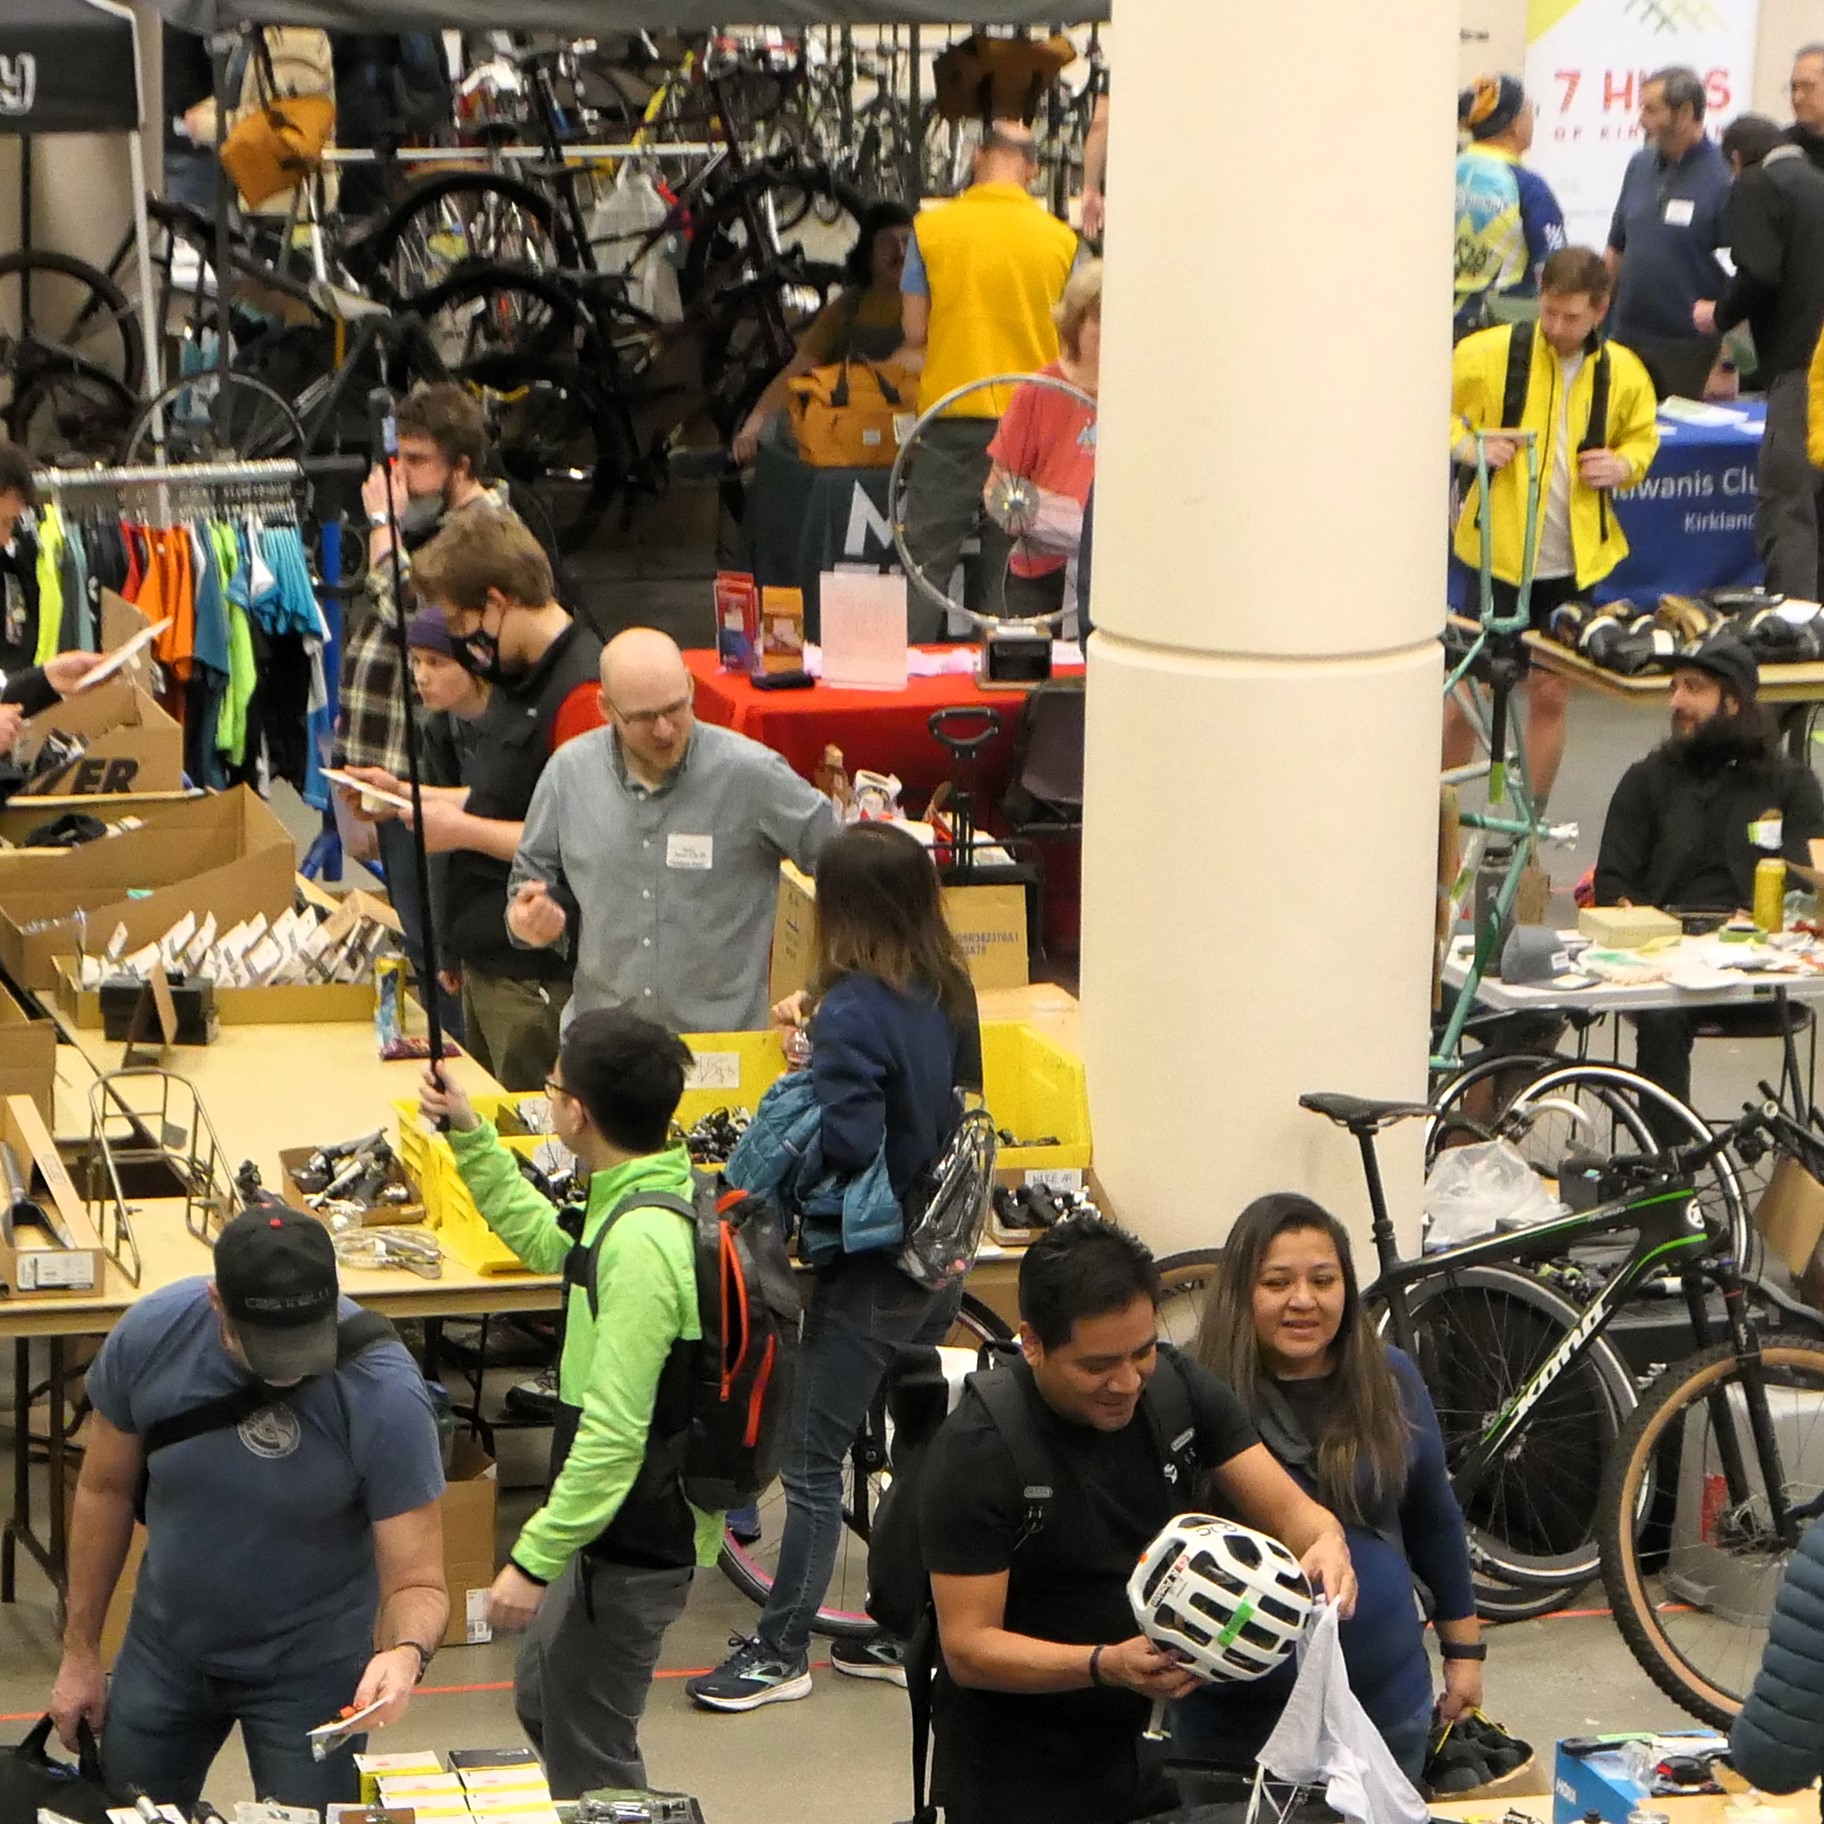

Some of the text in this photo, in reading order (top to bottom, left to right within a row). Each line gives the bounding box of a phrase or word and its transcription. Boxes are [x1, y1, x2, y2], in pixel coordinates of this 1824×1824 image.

[1554, 67, 1582, 116] 7
[1612, 464, 1759, 502] wanis Clu
